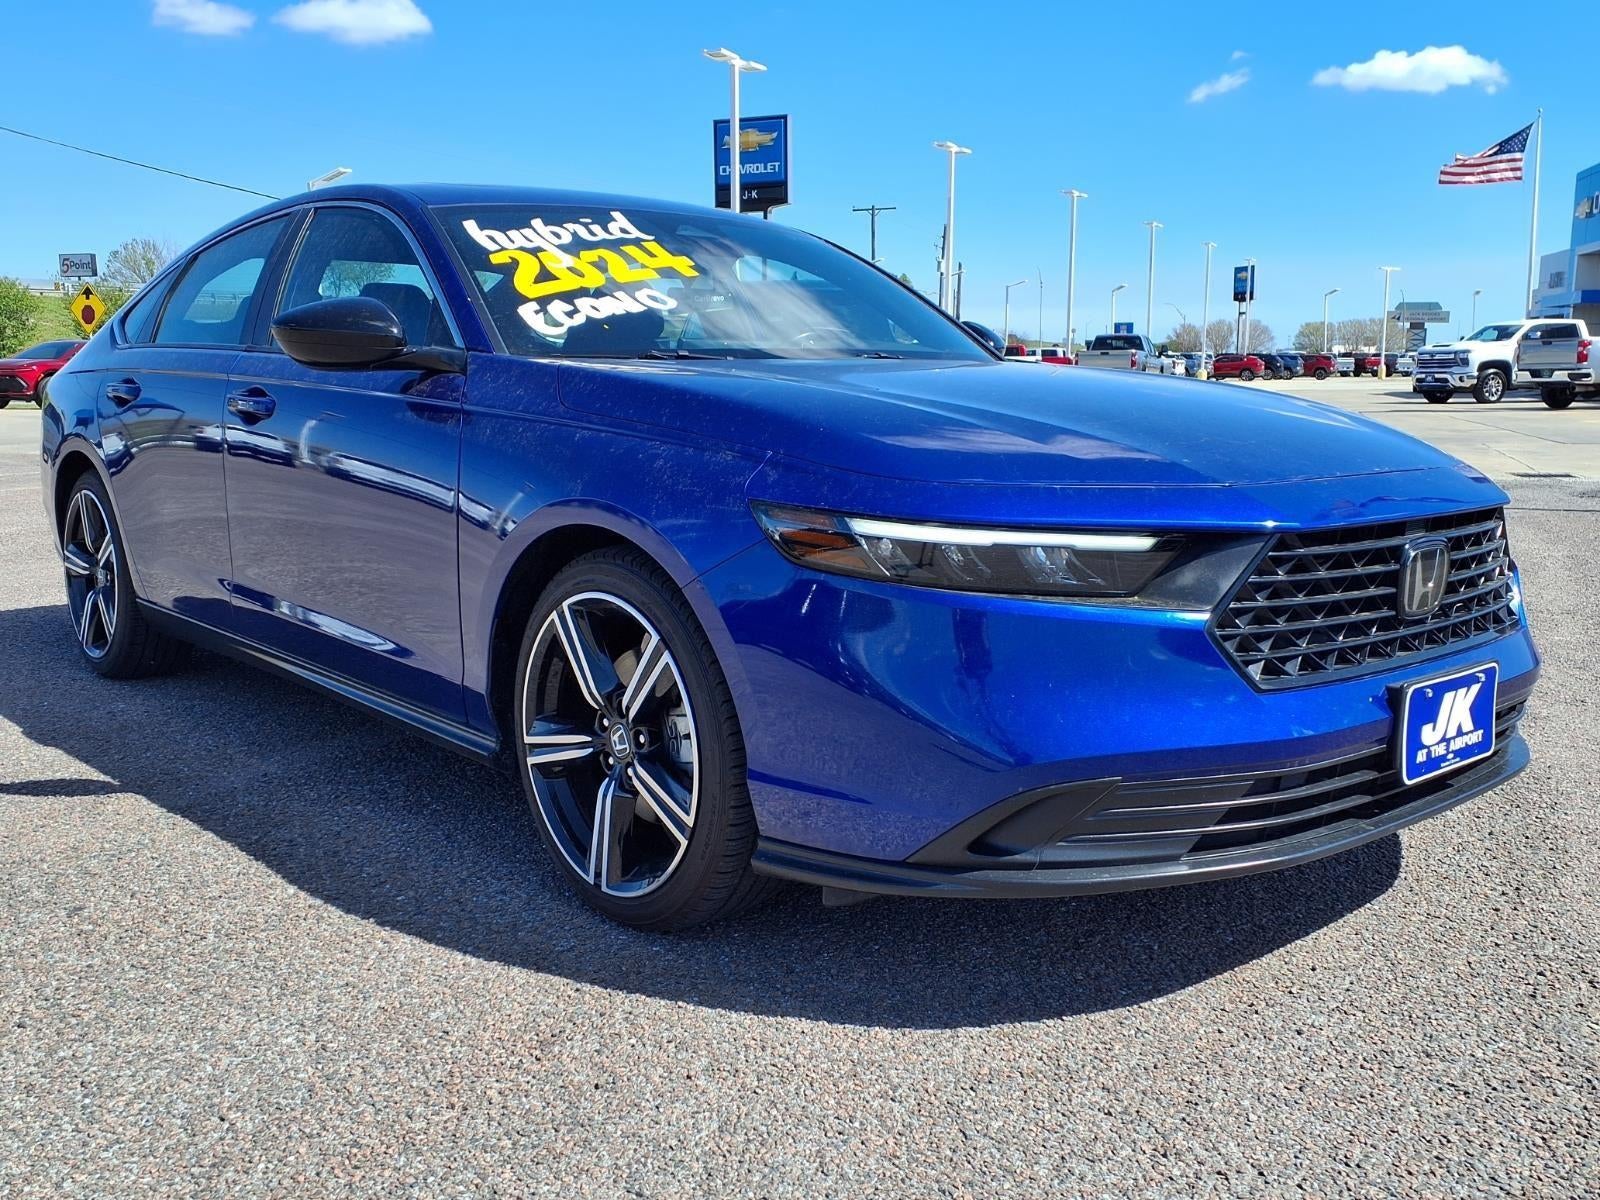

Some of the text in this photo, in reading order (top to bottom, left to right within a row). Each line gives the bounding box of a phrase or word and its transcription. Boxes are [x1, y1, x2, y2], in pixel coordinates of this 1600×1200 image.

[719, 162, 781, 176] CHVROLET
[742, 190, 758, 200] J-K
[462, 211, 656, 267] hybrid
[489, 241, 700, 299] 2024
[1421, 682, 1483, 746] JK
[1416, 748, 1428, 764] AT
[1431, 741, 1447, 759] THE
[1449, 729, 1484, 752] AIRPORT
